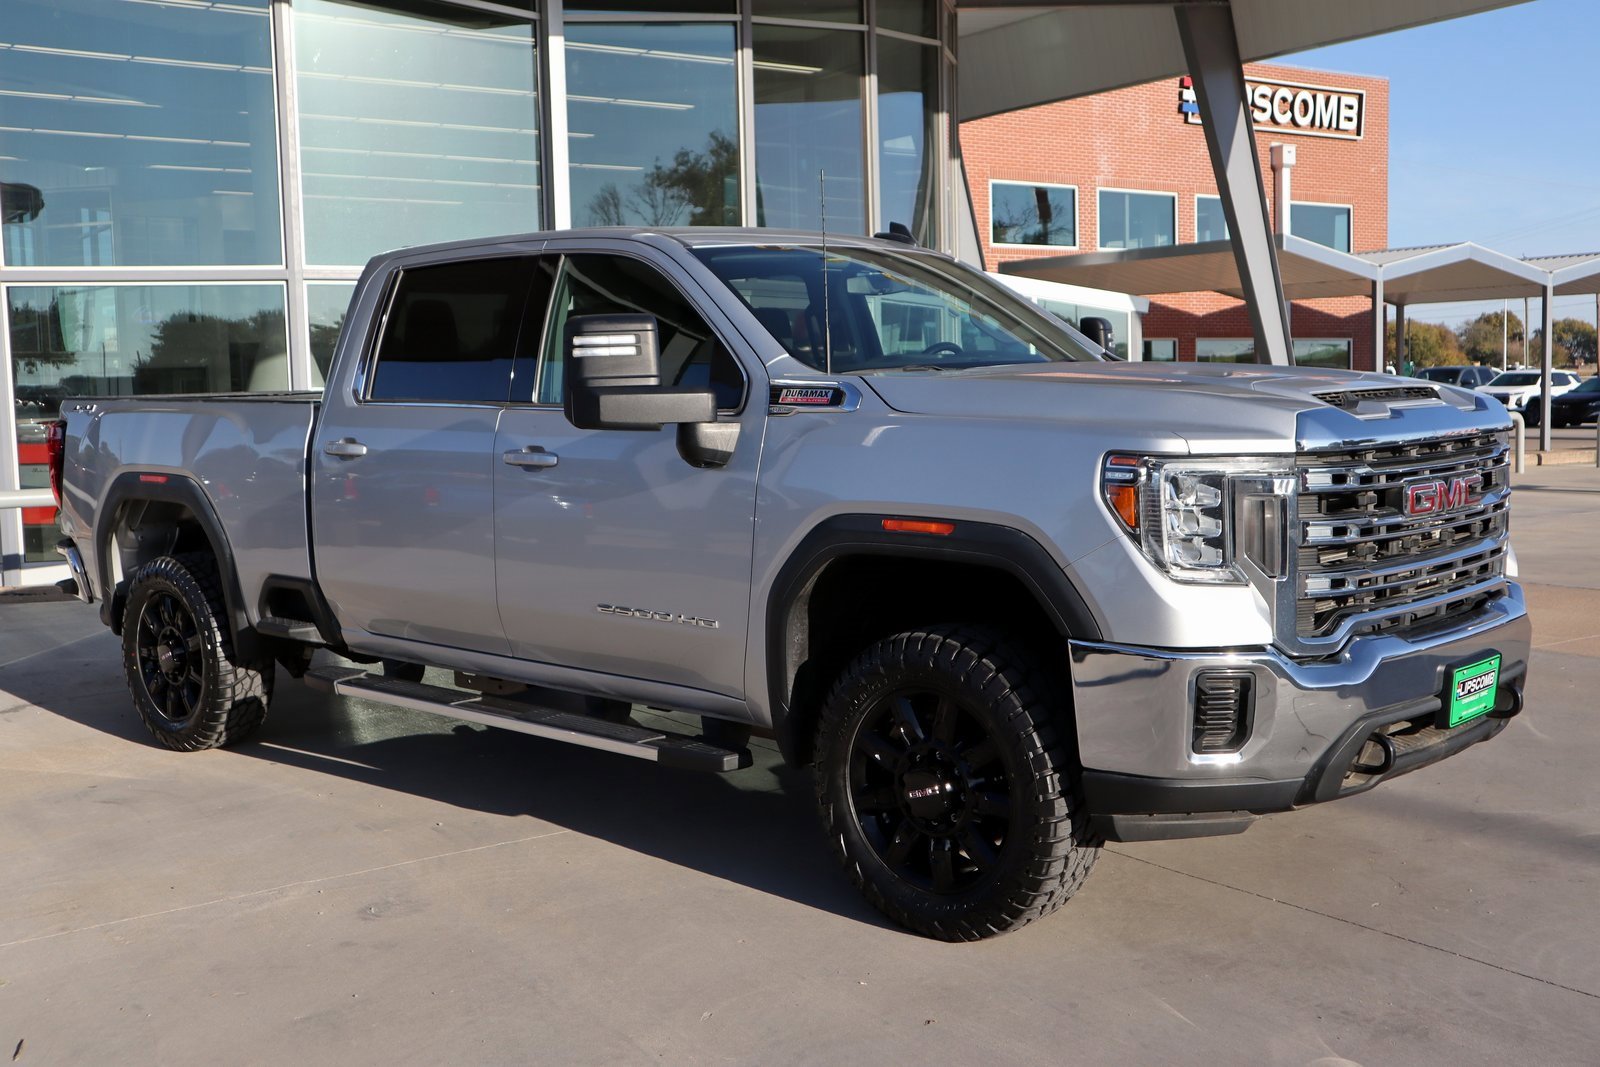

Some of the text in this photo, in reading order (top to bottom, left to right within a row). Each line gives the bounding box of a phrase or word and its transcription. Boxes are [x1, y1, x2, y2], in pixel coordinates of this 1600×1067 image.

[785, 388, 831, 398] DURAMAX
[1409, 475, 1482, 515] GMC
[677, 614, 719, 629] HD
[1460, 671, 1496, 696] LIPSCOMB
